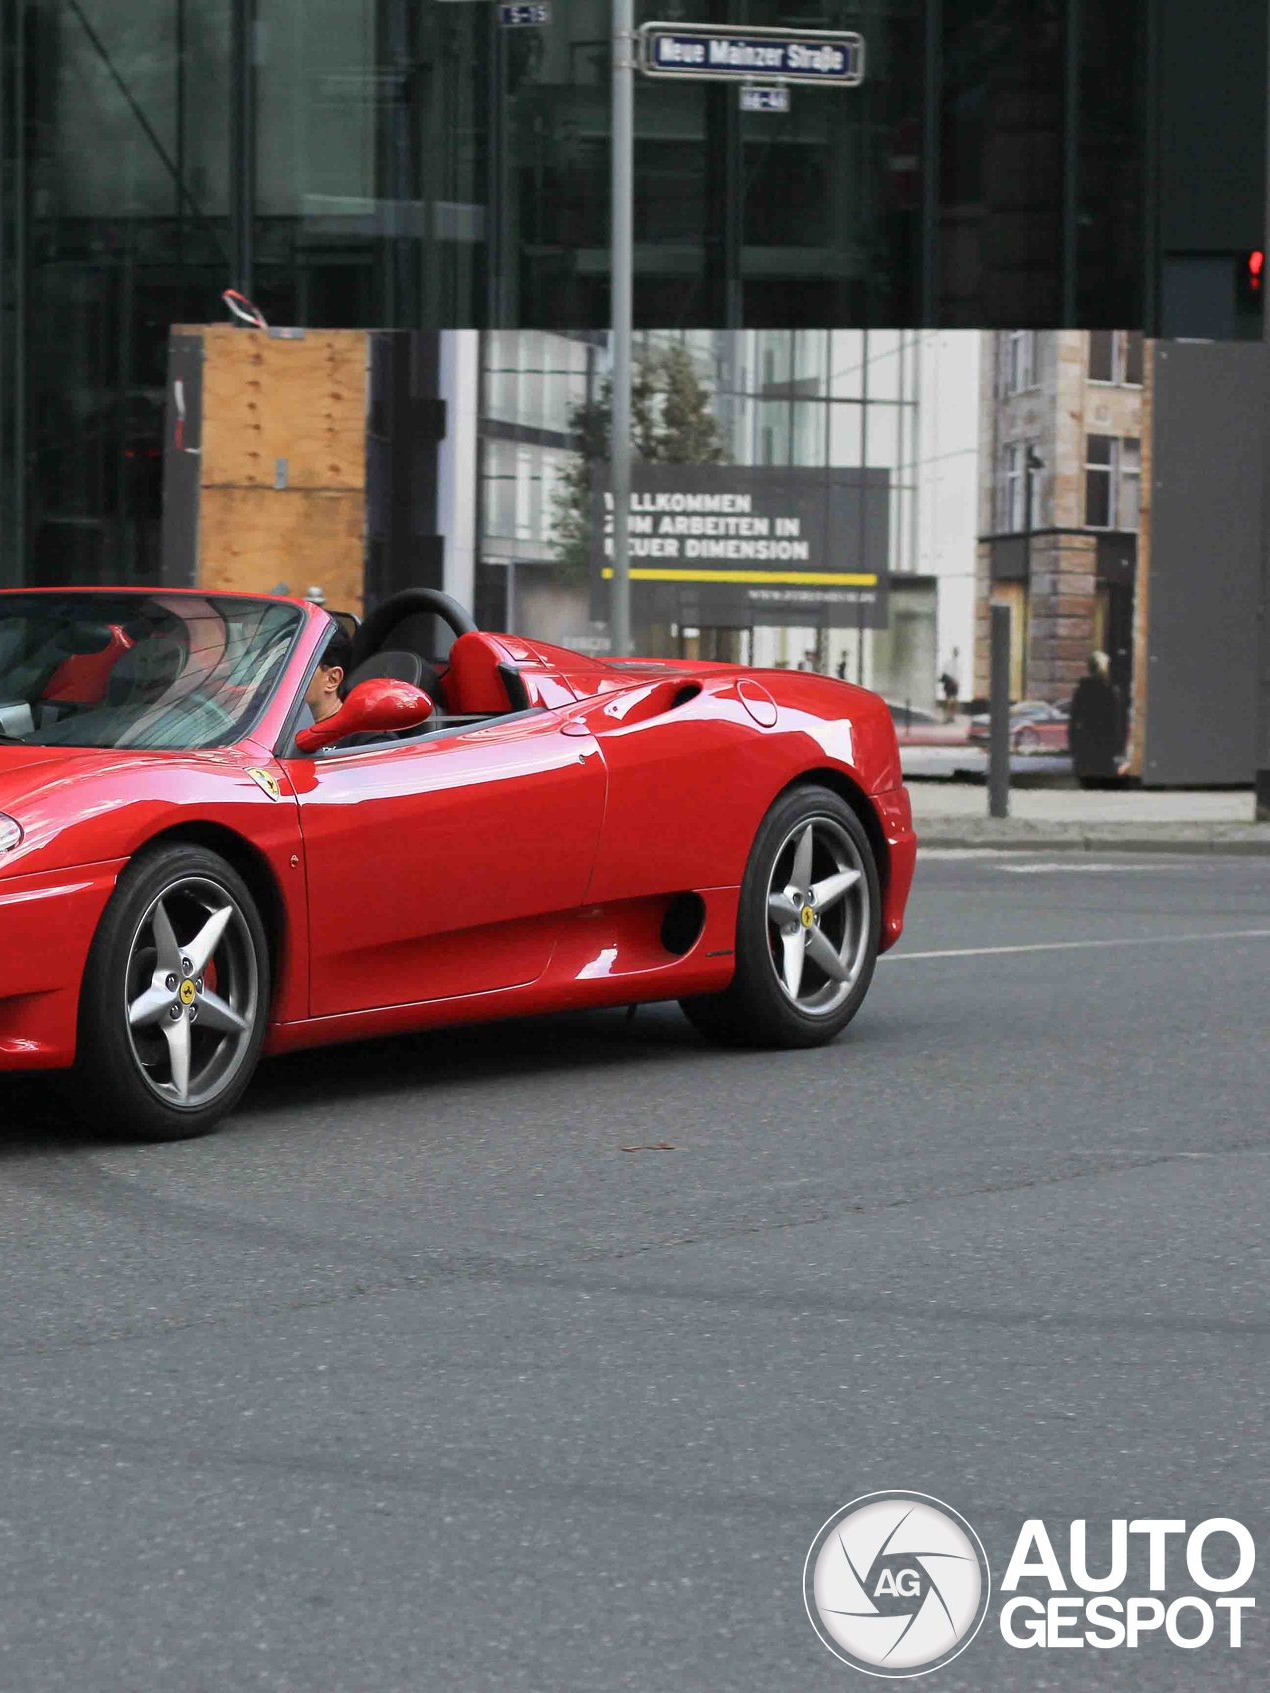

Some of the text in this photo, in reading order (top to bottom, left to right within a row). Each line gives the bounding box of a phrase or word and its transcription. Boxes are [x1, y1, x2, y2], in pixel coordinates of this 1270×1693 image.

[660, 38, 844, 71] Neue Mainzer Straße
[658, 515, 769, 537] ARBEITEN
[775, 517, 800, 538] IN
[685, 539, 809, 561] DIMENSION
